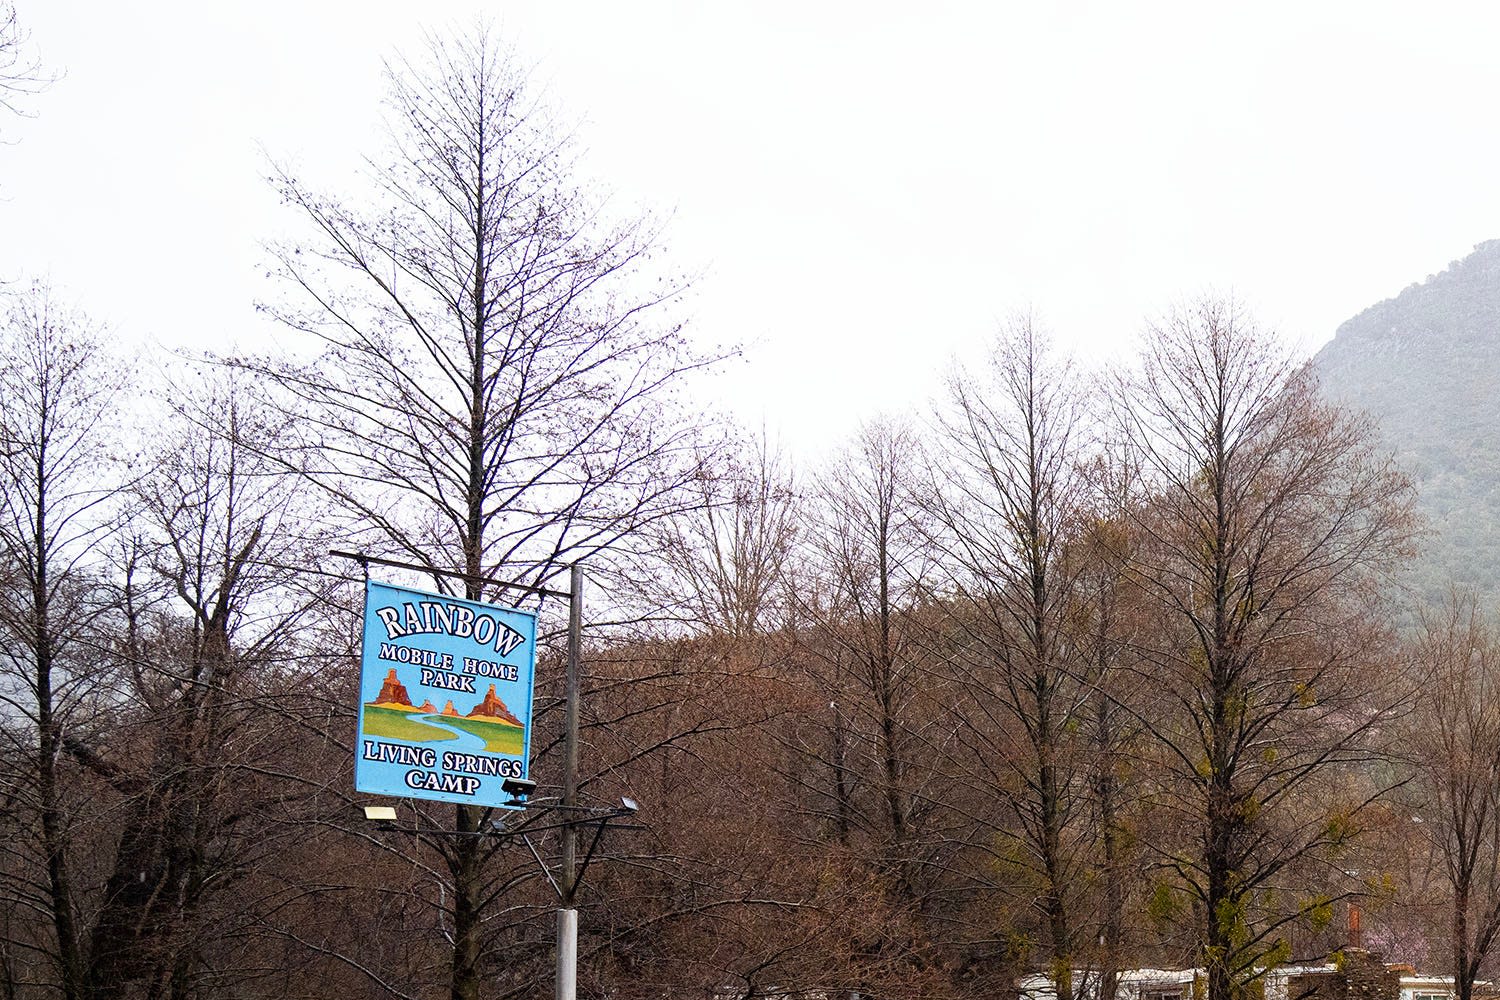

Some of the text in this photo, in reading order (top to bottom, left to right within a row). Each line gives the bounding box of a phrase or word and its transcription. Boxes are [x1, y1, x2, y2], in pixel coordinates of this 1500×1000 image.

[377, 601, 526, 657] RAINBOW
[379, 643, 519, 682] MOBILE HOME
[421, 669, 477, 693] PARK
[364, 741, 523, 779] LIVING SPRINGS
[405, 769, 481, 795] CAMP
